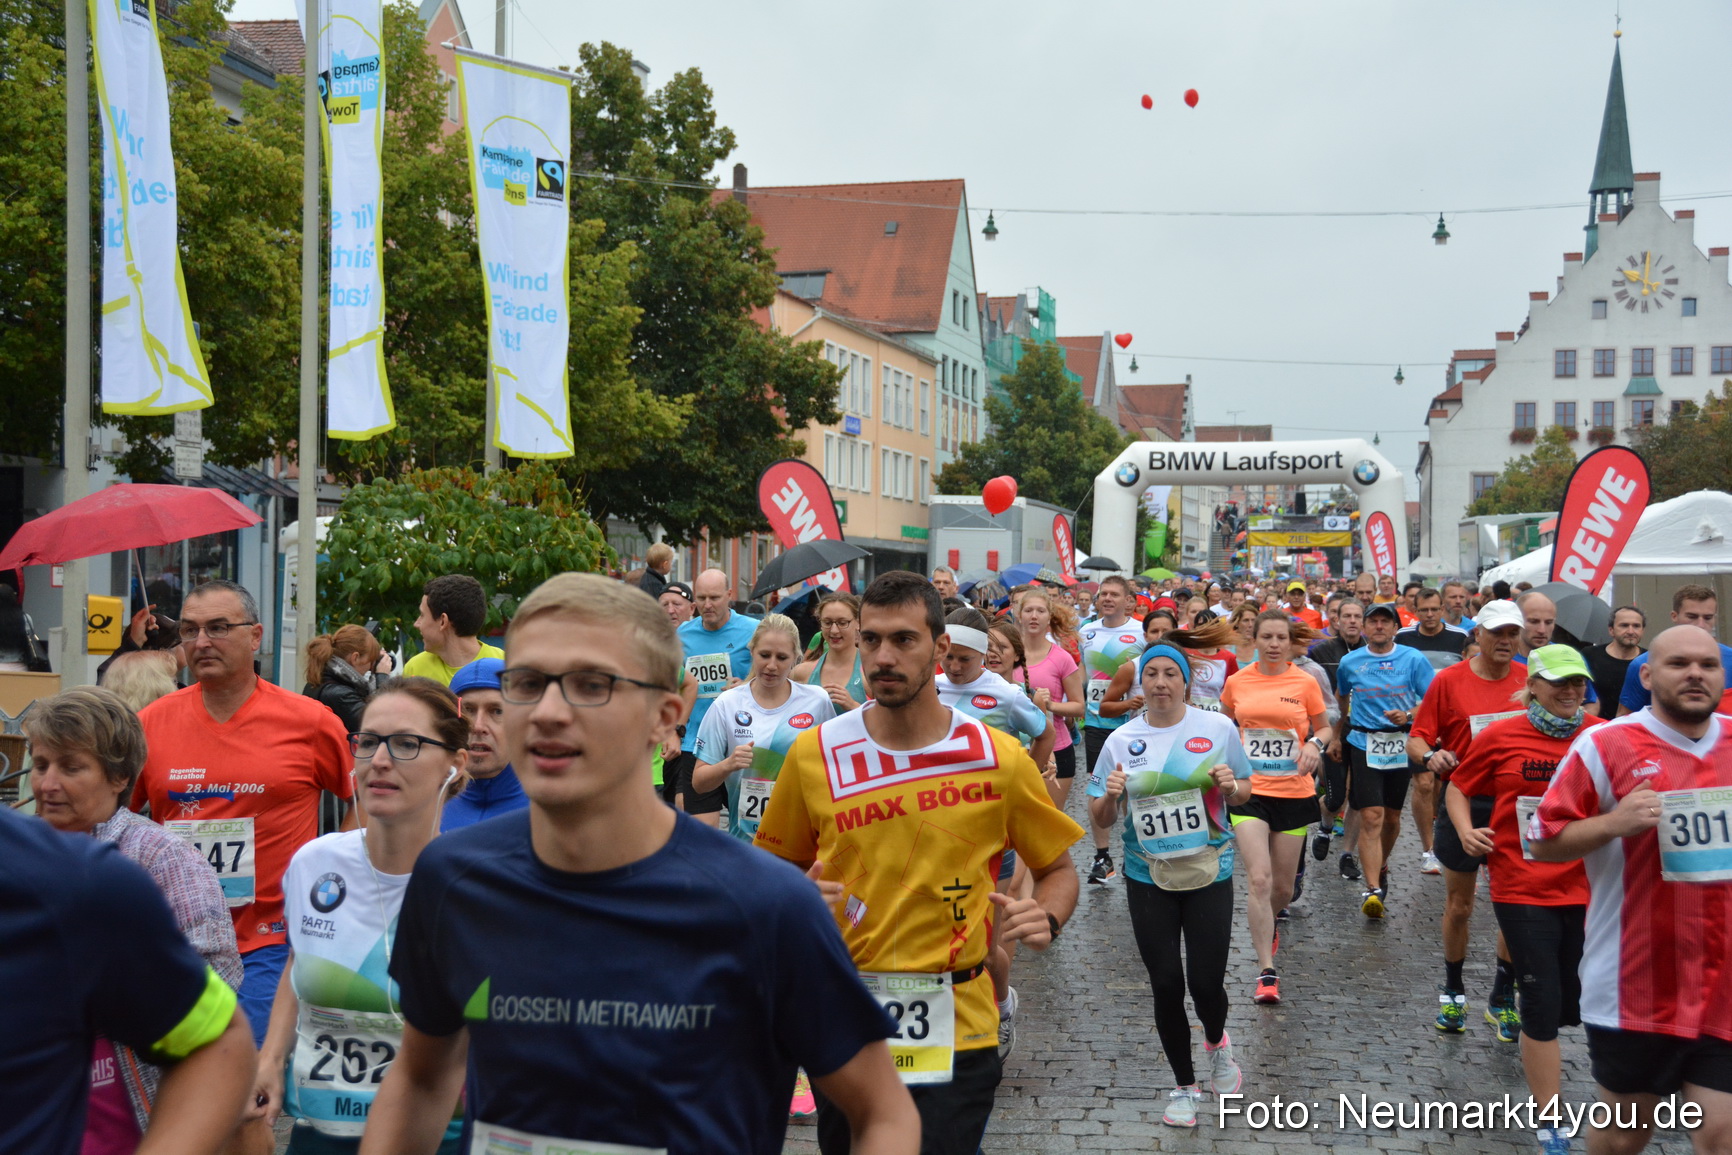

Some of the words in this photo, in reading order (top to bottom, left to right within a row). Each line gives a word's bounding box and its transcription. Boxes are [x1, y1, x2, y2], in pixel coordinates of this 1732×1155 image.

[1148, 450, 1216, 471] BMW
[1222, 450, 1344, 475] Laufsport
[1558, 466, 1637, 592] REWE
[1288, 535, 1312, 544] ZIEL
[690, 663, 728, 683] 2069
[1188, 741, 1210, 750] Hervis
[1249, 739, 1294, 758] 2437
[1371, 740, 1405, 754] 2723
[1128, 757, 1148, 766] PARTL
[1262, 762, 1281, 770] Anita
[170, 767, 207, 775] Regensburg
[1525, 769, 1542, 779] RUN
[1632, 765, 1659, 778] PUMA
[185, 783, 205, 795] 28.
[207, 782, 231, 794] Mai
[232, 783, 265, 794] 2006
[834, 795, 908, 834] MAX
[916, 780, 1002, 812] BÖGL
[198, 821, 245, 834] BOCK
[1140, 805, 1201, 837] 3115
[1669, 809, 1730, 847] 301
[1156, 839, 1185, 852] Anna
[301, 914, 337, 932] PARTL
[299, 926, 335, 940] Neumarkt
[886, 976, 944, 991] BOCK
[491, 995, 571, 1023] GOSSEN
[576, 1000, 717, 1030] METRAWATT
